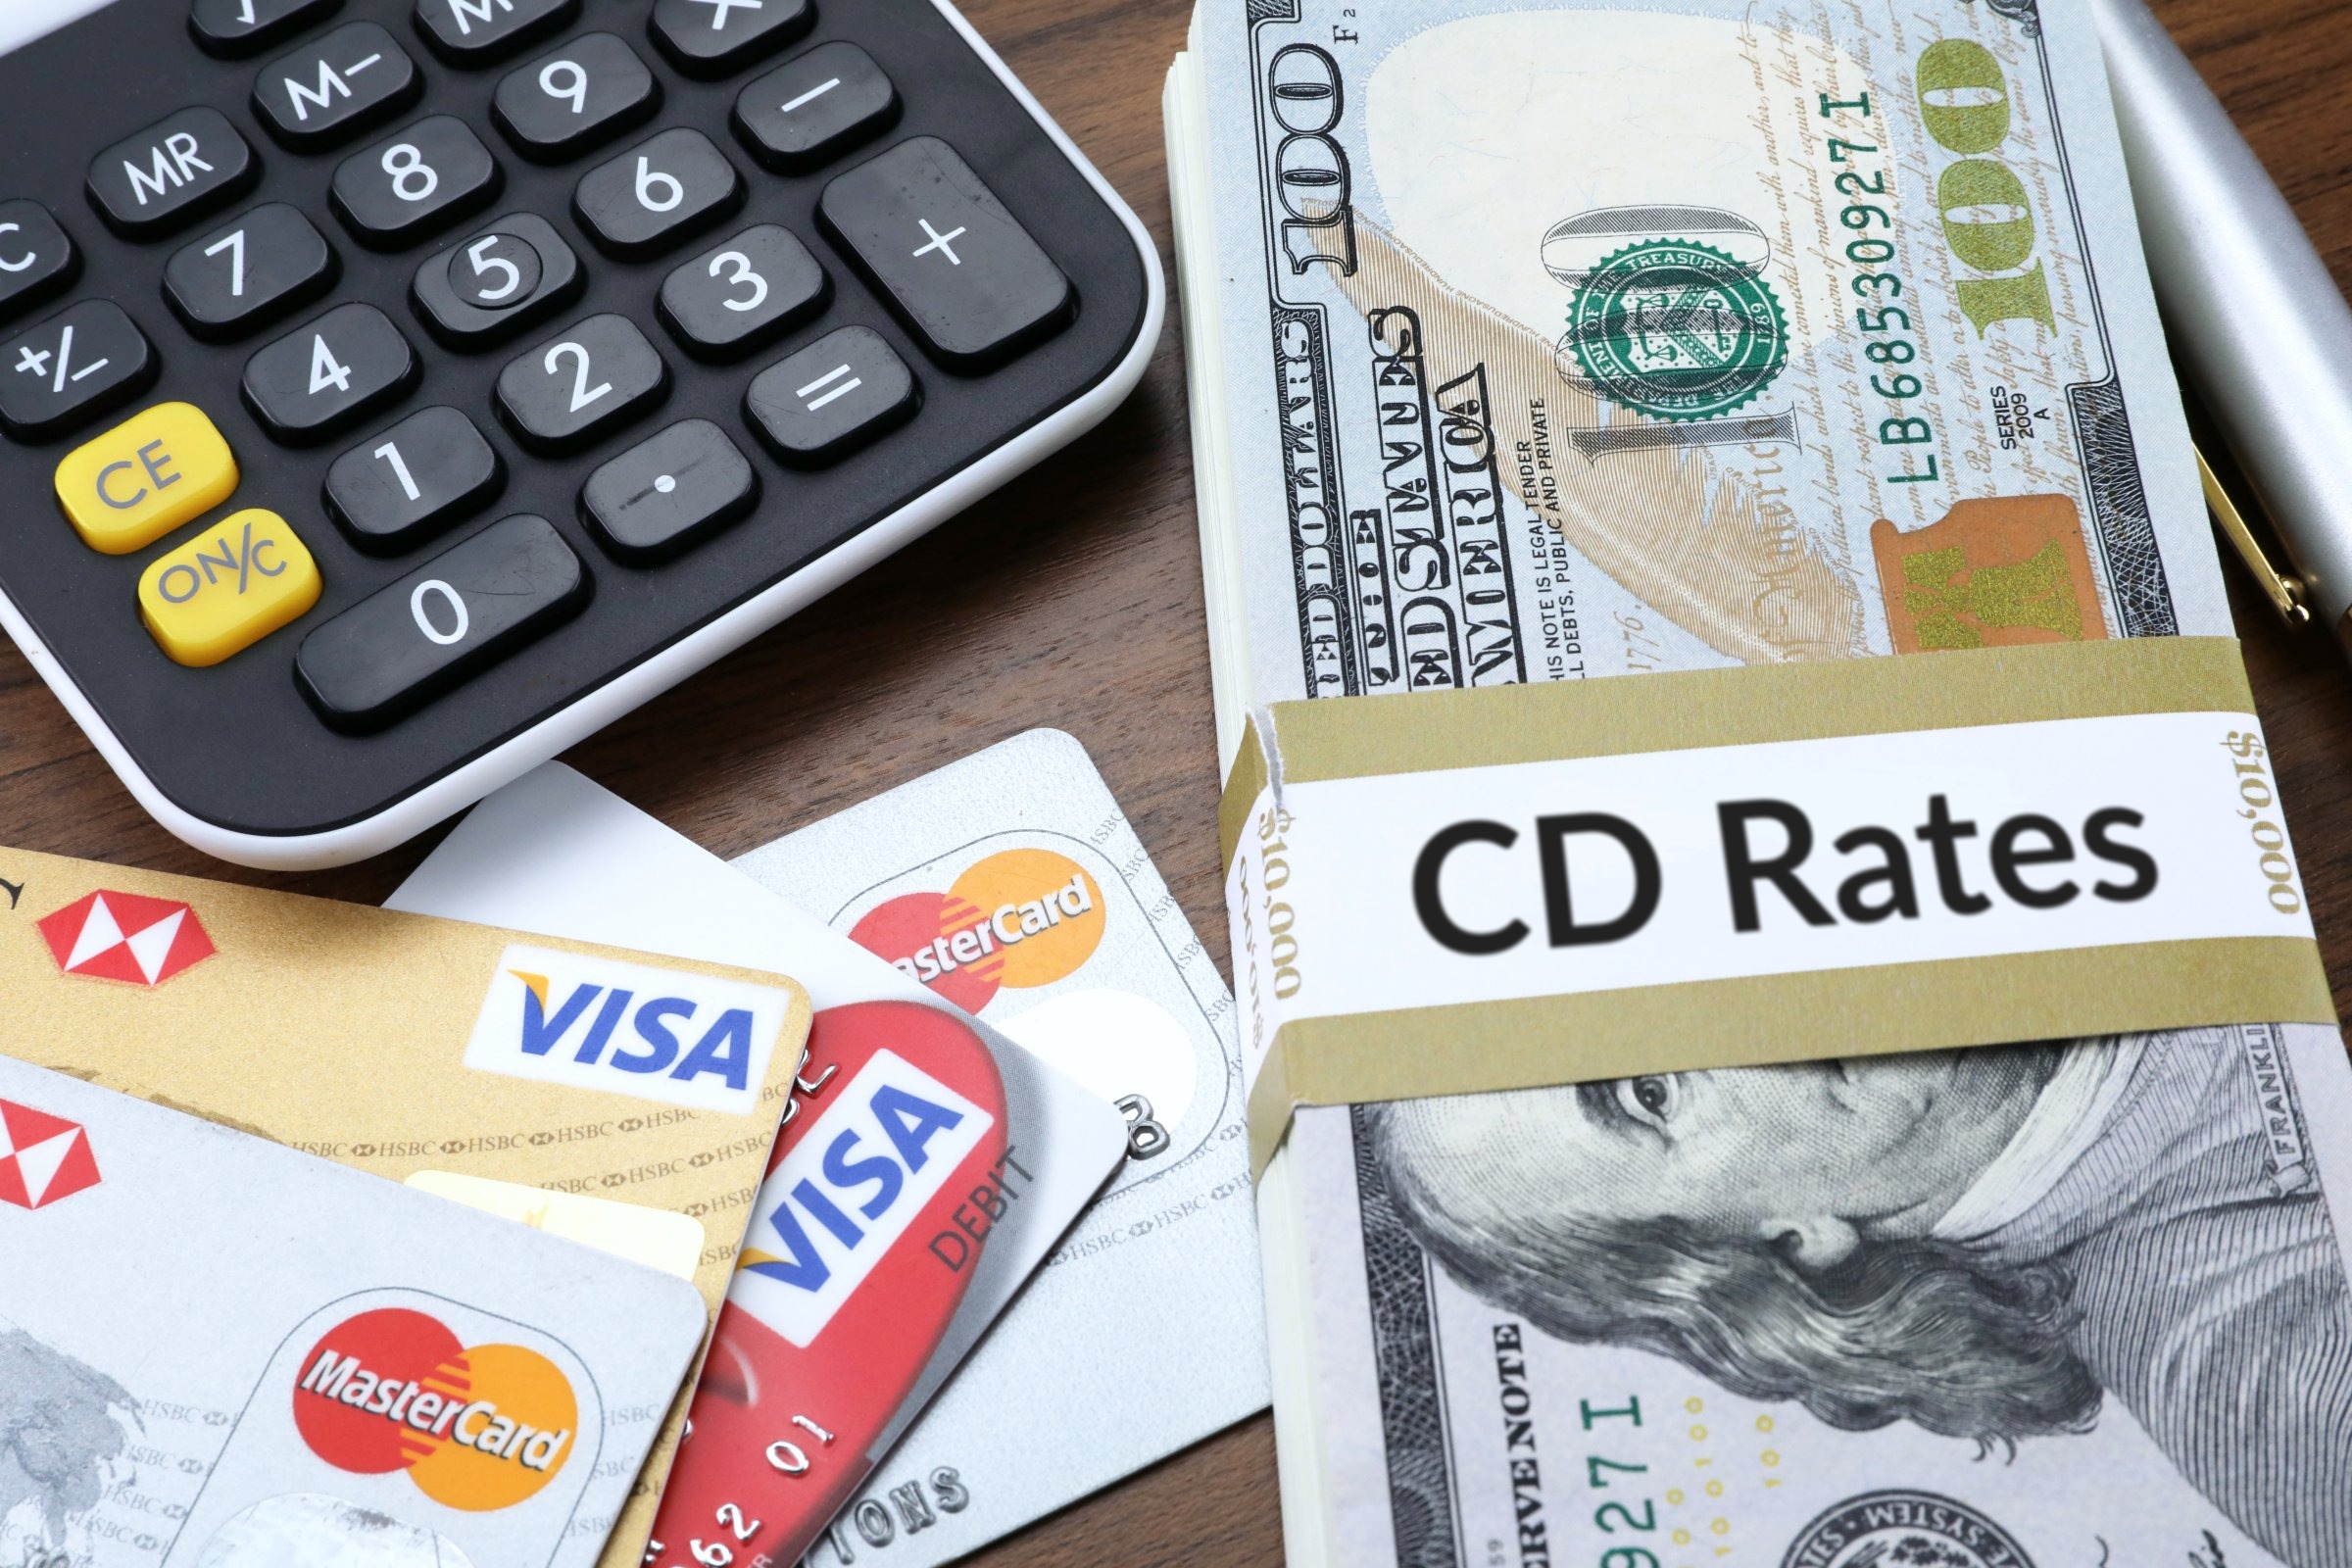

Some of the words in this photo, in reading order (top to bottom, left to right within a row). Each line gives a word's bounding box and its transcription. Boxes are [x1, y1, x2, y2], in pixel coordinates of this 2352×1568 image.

[538, 60, 588, 114] 9
[1739, 53, 1764, 91] and
[1770, 48, 1802, 88] that
[1788, 96, 1821, 155] requires
[123, 131, 215, 205] MR
[380, 143, 438, 202] 8
[635, 156, 684, 213] 6
[1268, 42, 1358, 277] 100
[1916, 37, 2058, 340] 100
[1756, 172, 1788, 213] with
[1787, 158, 1830, 246] mankind
[204, 229, 246, 296] 7
[466, 234, 520, 301] 5
[1768, 219, 1795, 259] them
[1806, 247, 1845, 270] of
[709, 251, 768, 312] 3
[1773, 259, 1810, 336] connected
[308, 333, 352, 396] 4
[543, 341, 613, 414] 2
[1790, 338, 1818, 378] have
[1530, 398, 1554, 470] PRIVATE
[1791, 385, 1829, 436] which
[1990, 385, 2017, 451] SERIES
[2010, 392, 2035, 440] 2009
[2034, 407, 2050, 420] A
[95, 438, 183, 511] CE
[373, 440, 421, 502] 1
[1280, 317, 1332, 588] DOLLARS
[1367, 306, 1450, 592] STATES
[1516, 441, 1540, 510] TENDER
[1807, 444, 1839, 501] bands
[1540, 476, 1560, 512] AND
[158, 521, 288, 605] ON/C
[1527, 514, 1549, 569] LEGAL
[1547, 518, 1570, 582] PUBLIC
[410, 578, 469, 646] 0
[1350, 510, 1399, 686] THE
[1536, 576, 1552, 593] IS
[1539, 600, 1560, 648] NOTE
[1558, 590, 1582, 654] DEBTS,
[2221, 730, 2301, 914] $10,000
[1256, 807, 1302, 1000] $10,000
[507, 969, 755, 1091] VISA
[378, 1140, 437, 1157] HSBC
[467, 1133, 525, 1152] HSBC
[557, 1121, 614, 1143] HSBC
[627, 1158, 687, 1183] HSBC
[716, 1131, 772, 1161] HSBC
[737, 1084, 964, 1294] VISA
[928, 1146, 1035, 1273] DEBIT
[1069, 1229, 1127, 1261] HSBC
[1153, 1194, 1208, 1228] HSBC
[300, 1348, 572, 1473] MasterCard
[1493, 1323, 1536, 1451] NOTE
[1864, 1501, 1985, 1547] SYSTEM
